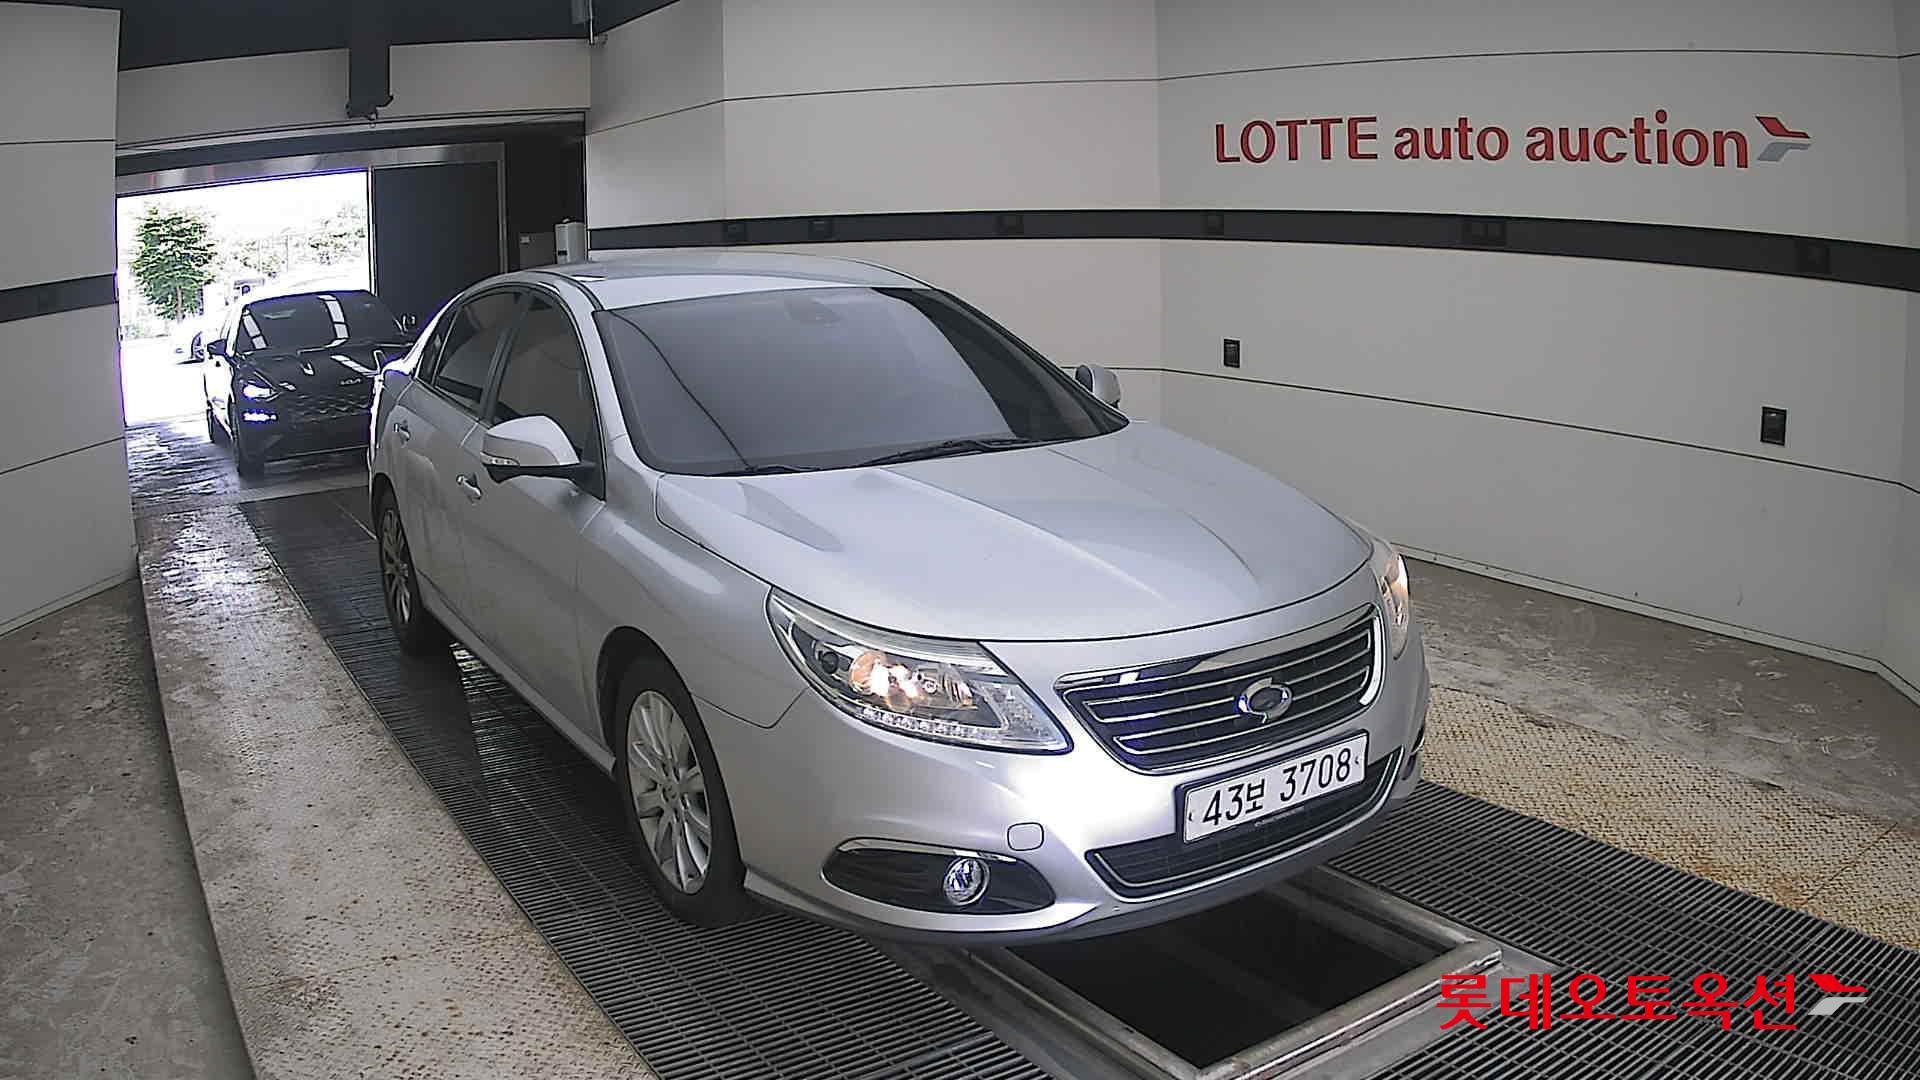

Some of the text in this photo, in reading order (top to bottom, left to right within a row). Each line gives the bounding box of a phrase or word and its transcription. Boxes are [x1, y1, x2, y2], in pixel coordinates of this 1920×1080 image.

[1215, 110, 1750, 169] LOTTE auto auction
[1202, 778, 1266, 826] 43보
[1279, 748, 1352, 803] 3708
